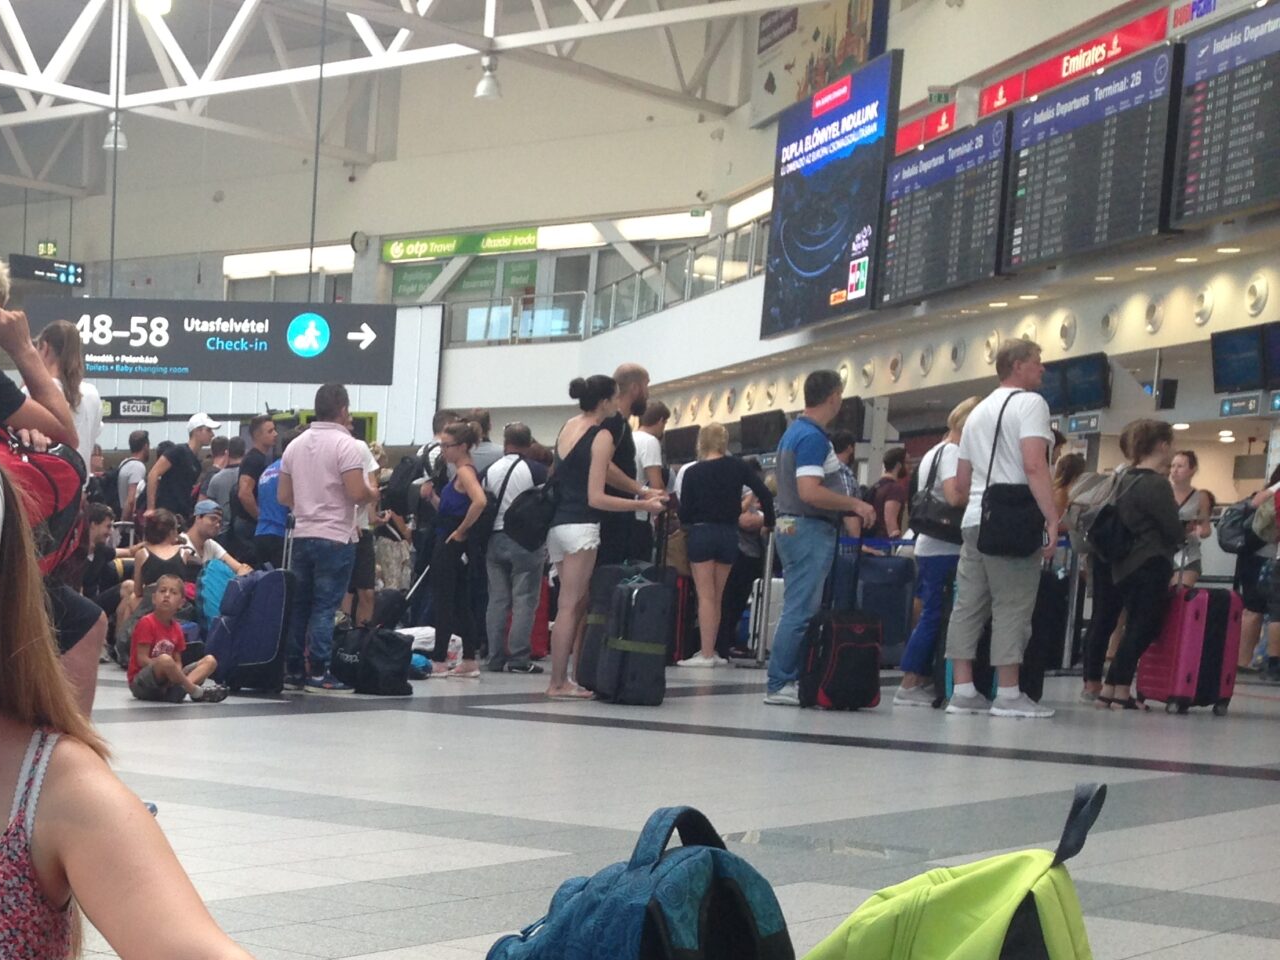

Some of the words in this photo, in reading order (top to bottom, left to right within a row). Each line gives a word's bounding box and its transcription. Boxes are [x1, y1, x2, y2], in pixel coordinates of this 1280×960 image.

[1061, 42, 1107, 78] Emirates
[1033, 106, 1055, 125] Indulás
[1056, 94, 1090, 118] Departures
[1094, 76, 1129, 101] Terminal:
[1130, 70, 1142, 88] 2B
[781, 139, 804, 163] DUPLA
[841, 100, 879, 134] INDULUNK
[406, 242, 429, 257] otp
[429, 240, 456, 252] Travel
[184, 317, 269, 333] Utasfelvétel
[206, 337, 268, 351] Check-in
[85, 363, 109, 371] Toilets
[116, 364, 133, 373] Baby
[134, 365, 168, 374] changing
[122, 405, 150, 413] SECURE
